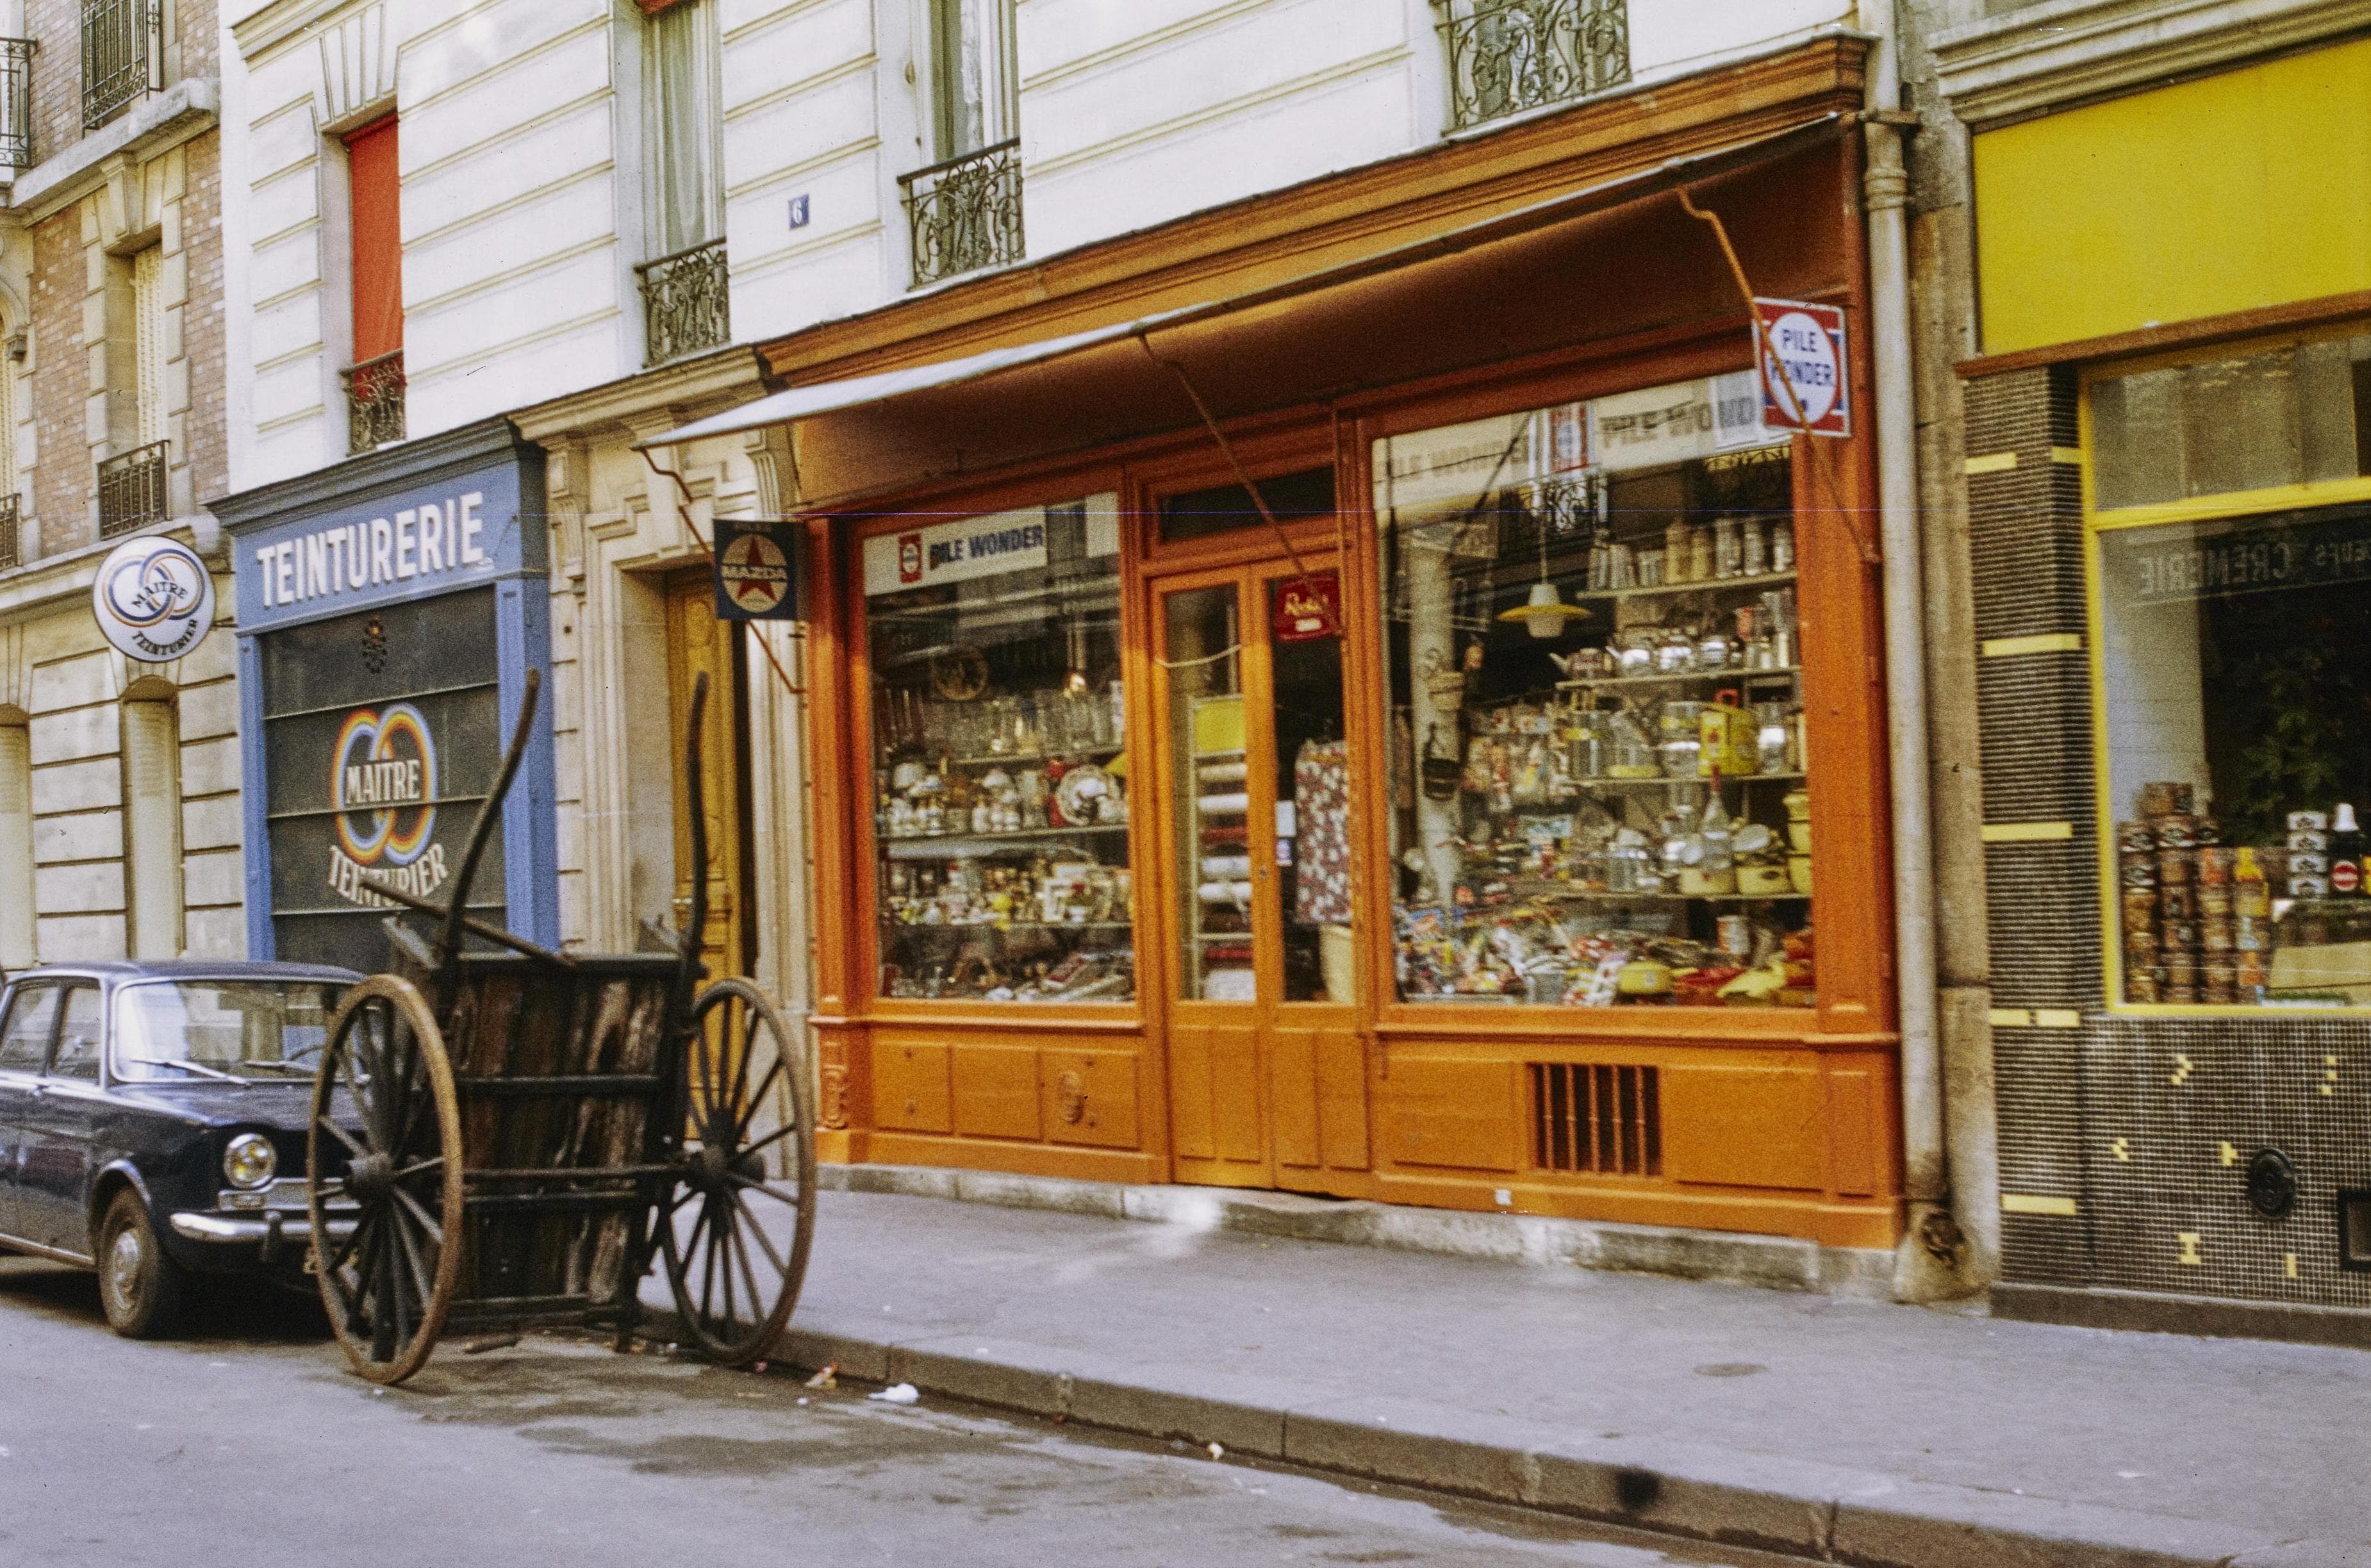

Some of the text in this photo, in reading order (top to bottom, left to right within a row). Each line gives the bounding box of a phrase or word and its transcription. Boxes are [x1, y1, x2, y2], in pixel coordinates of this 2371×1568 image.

[793, 199, 802, 224] 6
[1781, 327, 1816, 352] PILE
[256, 491, 483, 607] TEINTURERIE
[969, 524, 1045, 557] WONDER
[721, 565, 788, 581] MAZDA
[131, 581, 188, 608] MAITRE
[131, 618, 198, 656] TEINTURIER
[345, 759, 420, 804] MAITRE
